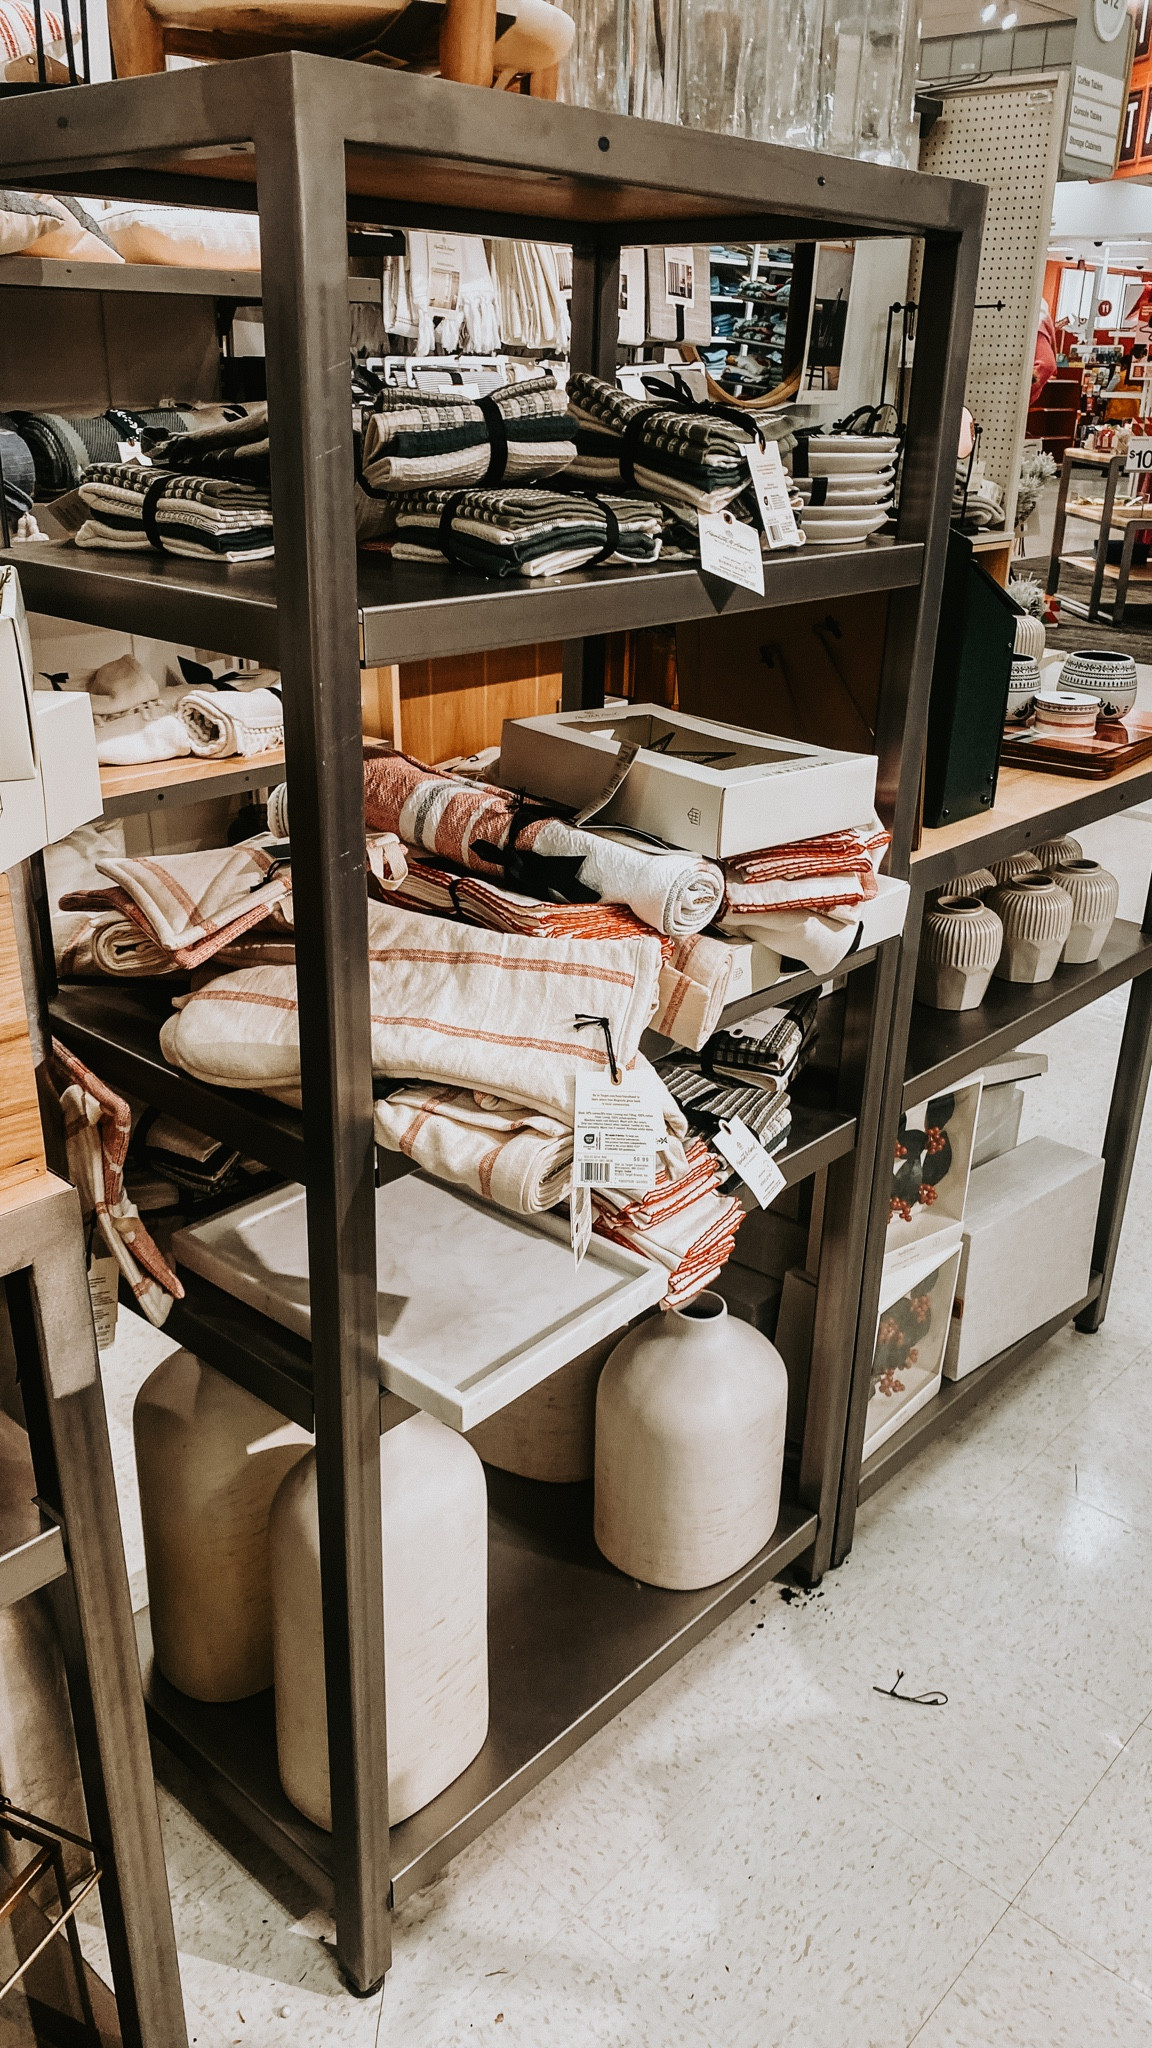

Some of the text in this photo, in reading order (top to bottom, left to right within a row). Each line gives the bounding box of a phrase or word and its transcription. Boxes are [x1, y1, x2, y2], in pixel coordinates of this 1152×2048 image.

[1091, 80, 1103, 91] Tables
[1090, 110, 1102, 122] Tables
[1101, 304, 1110, 314] 11
